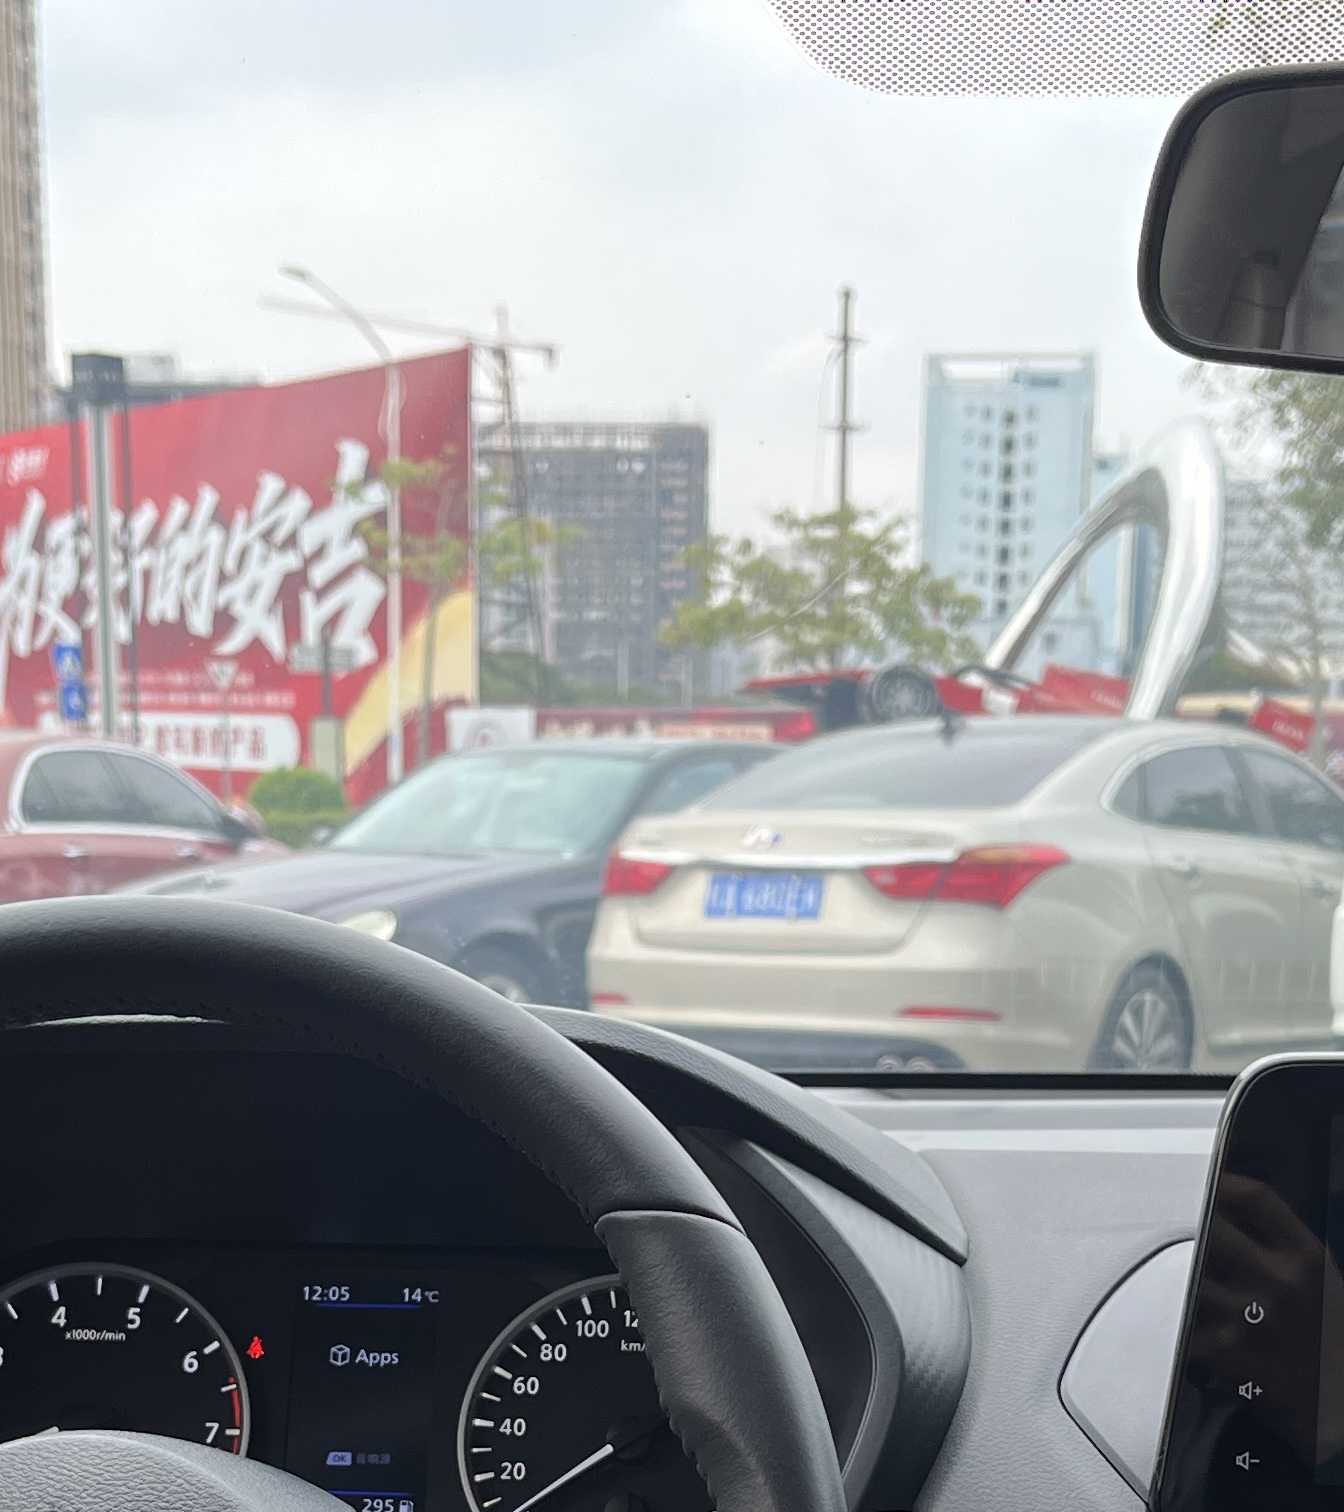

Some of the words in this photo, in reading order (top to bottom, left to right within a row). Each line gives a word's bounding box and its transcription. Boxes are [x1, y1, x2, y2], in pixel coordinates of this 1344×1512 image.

[303, 1285, 350, 1301] 12:05
[51, 1306, 67, 1327] 4
[127, 1307, 142, 1330] 5
[575, 1319, 610, 1338] 100
[182, 1350, 199, 1373] 6
[355, 1349, 399, 1367] Apps
[540, 1343, 567, 1362] 80
[513, 1376, 540, 1395] 60
[205, 1422, 220, 1443] 7
[499, 1417, 527, 1437] 40
[500, 1462, 527, 1481] 20
